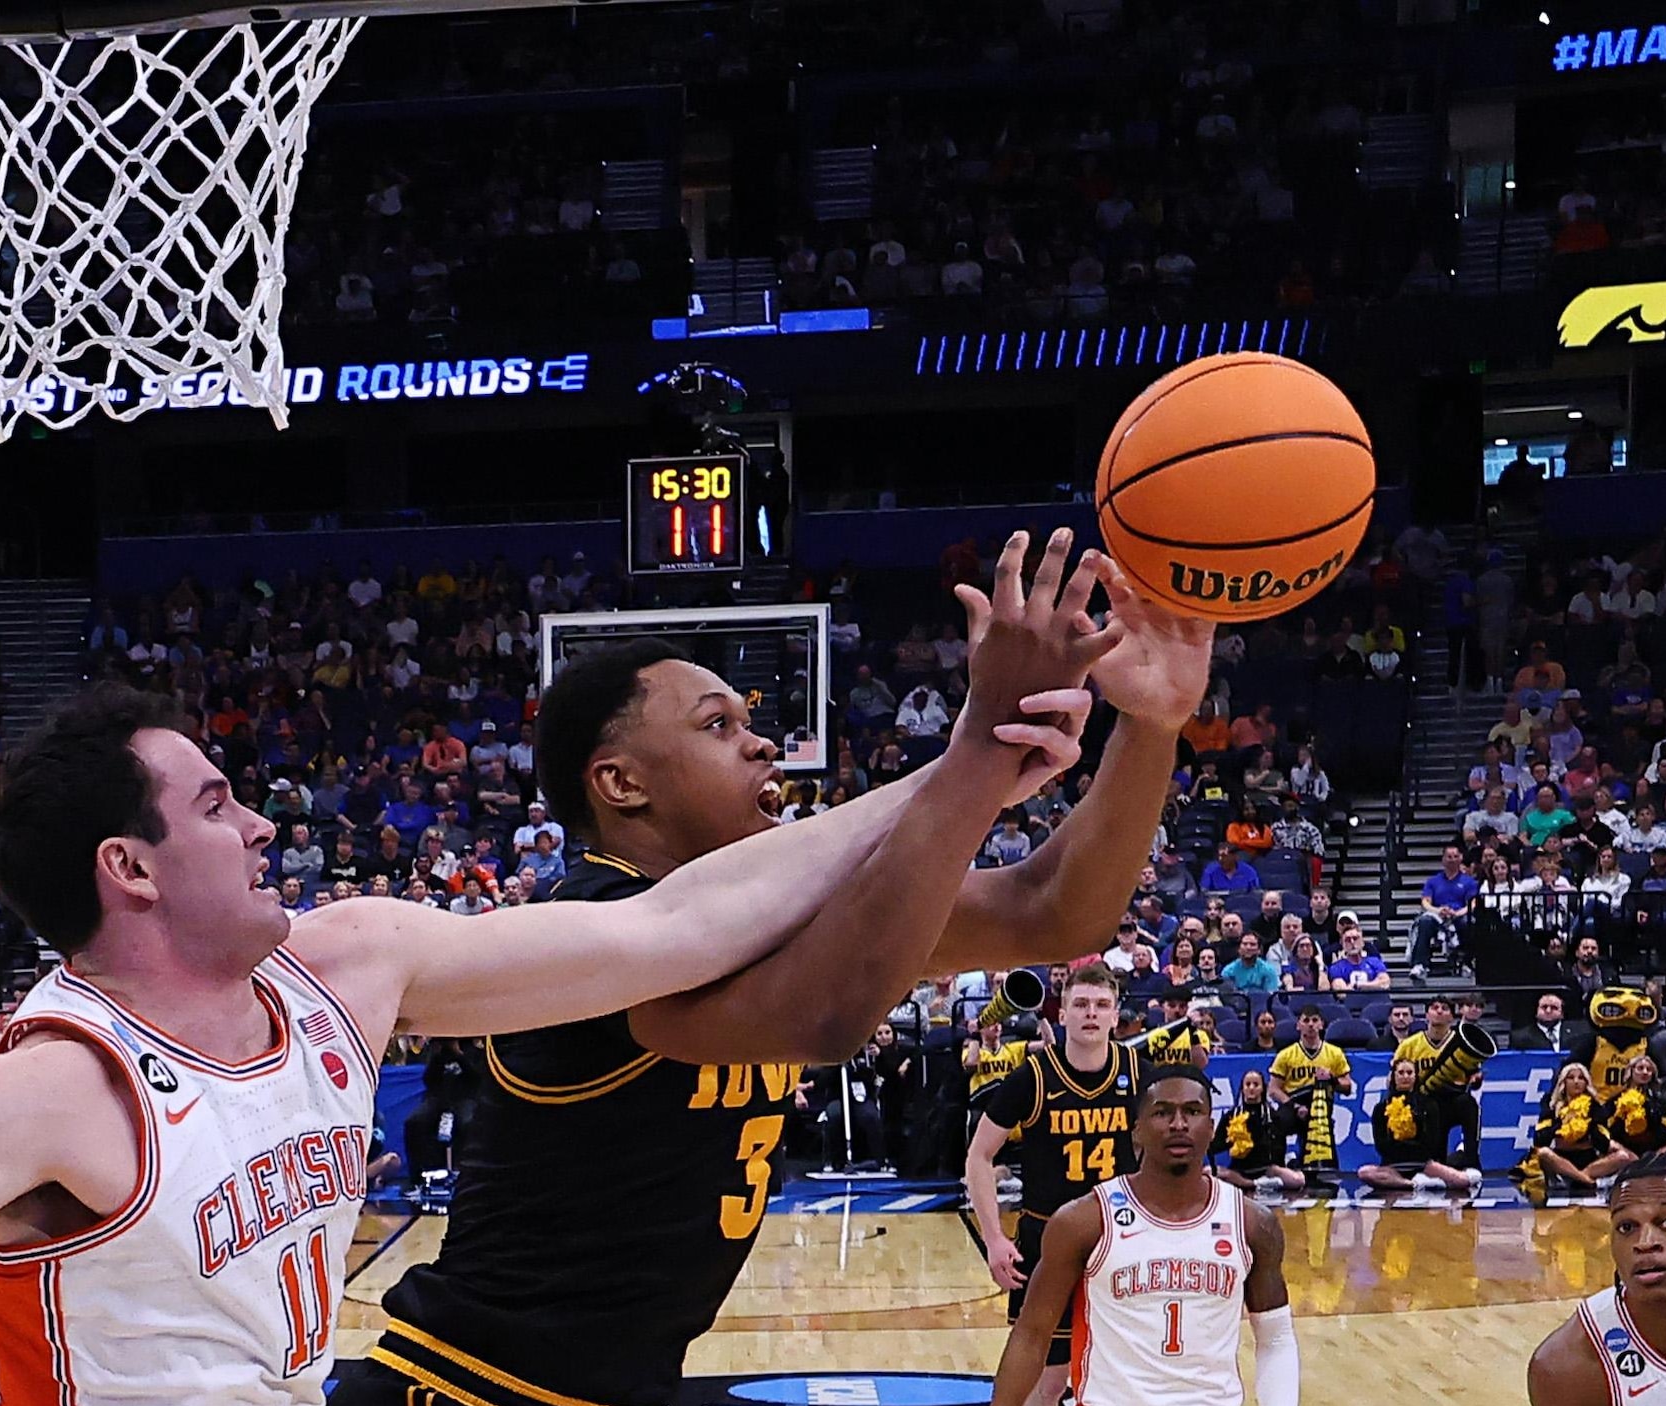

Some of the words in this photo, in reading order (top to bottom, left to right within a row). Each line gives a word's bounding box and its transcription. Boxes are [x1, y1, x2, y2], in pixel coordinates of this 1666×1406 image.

[337, 358, 533, 402] ROUNDS
[652, 466, 731, 501] 15:30
[1168, 549, 1345, 603] Wilson
[1291, 1066, 1318, 1080] IOW
[1049, 1106, 1129, 1135] IOWA
[719, 1113, 785, 1240] 3
[1062, 1138, 1117, 1182] 14
[1115, 1210, 1134, 1225] 41
[1111, 1257, 1239, 1301] CLEMSON
[277, 1224, 333, 1380] 11
[1161, 1299, 1183, 1357] 1
[1619, 1353, 1642, 1373] 41
